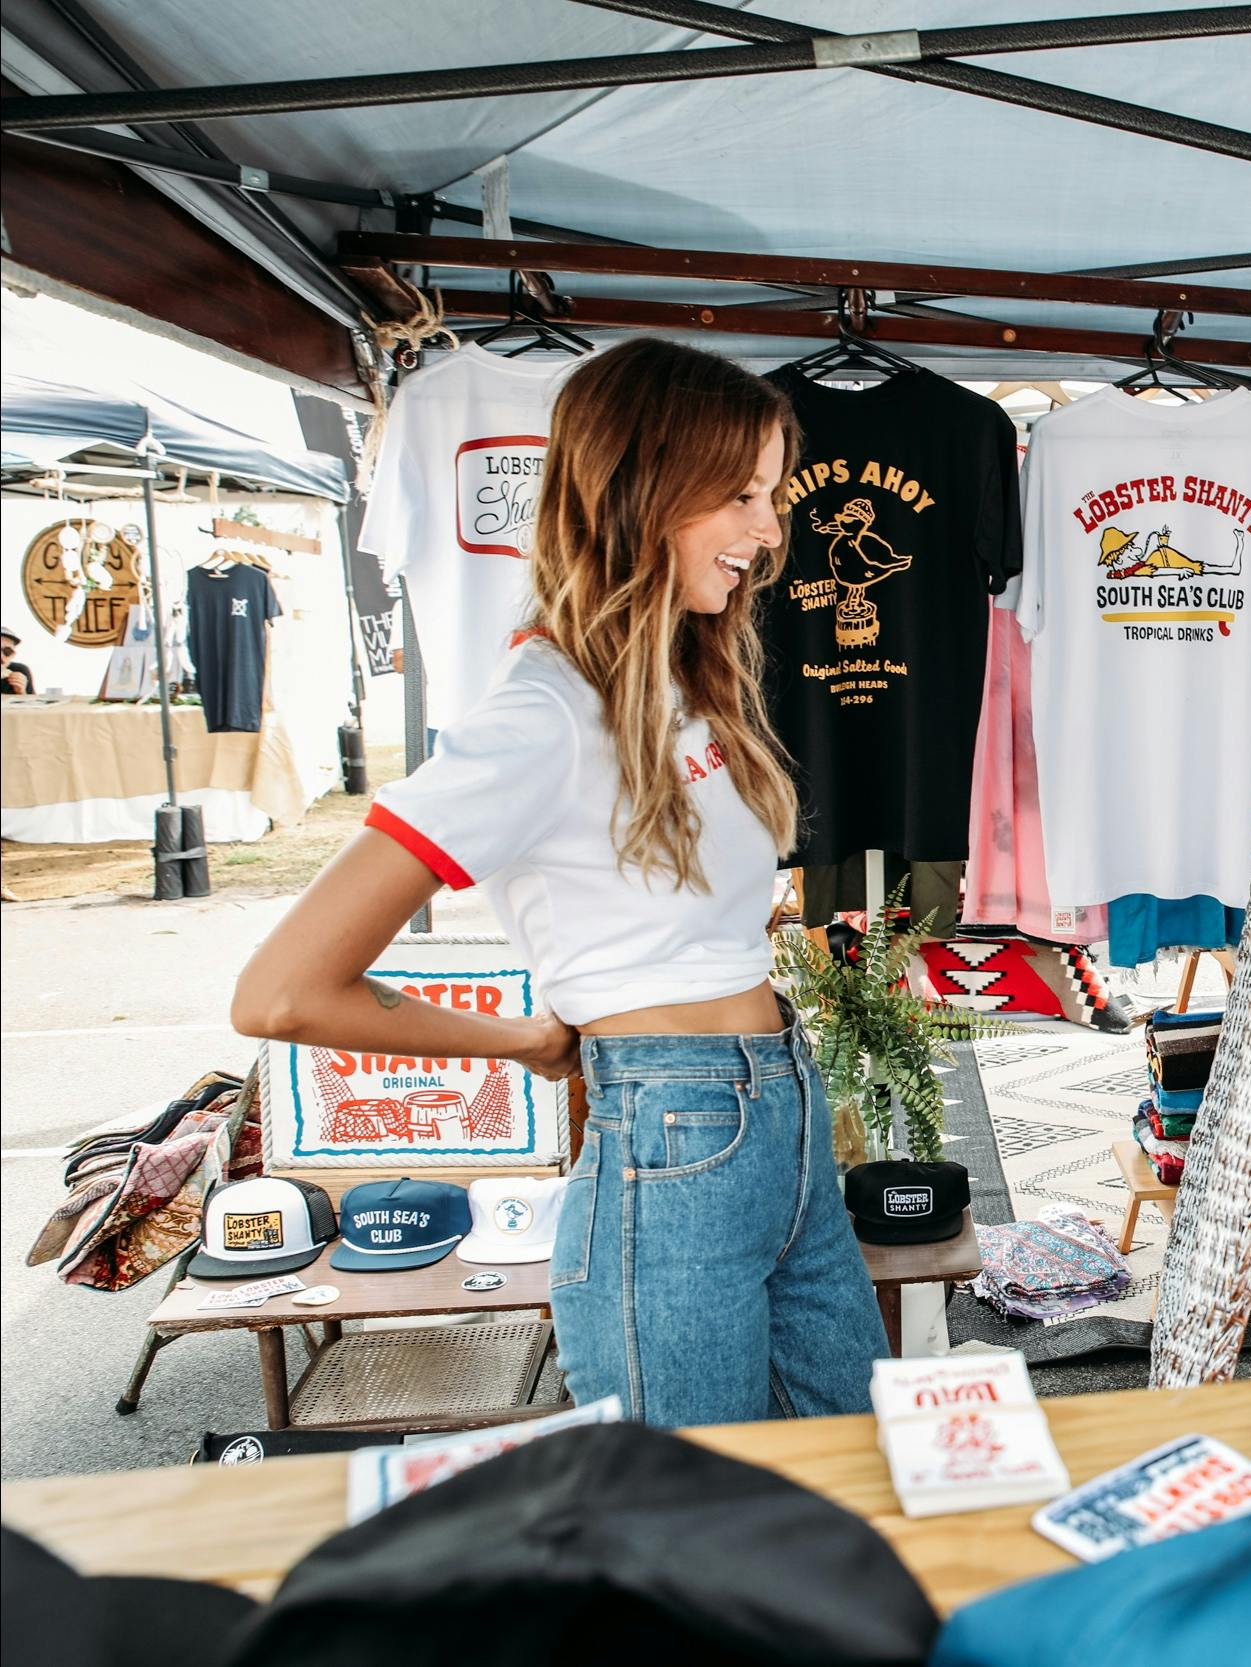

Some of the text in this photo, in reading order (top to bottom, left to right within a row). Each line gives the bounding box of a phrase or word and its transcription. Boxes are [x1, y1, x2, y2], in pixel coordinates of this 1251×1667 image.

[485, 456, 546, 476] LOBST
[777, 459, 936, 514] HIPS AHOY
[1081, 490, 1095, 503] THE
[474, 480, 538, 535] Sha
[1073, 475, 1177, 535] LOBSTER
[789, 579, 837, 600] LOBSTER
[1096, 585, 1245, 610] SOUTH SEA'S CLUB
[801, 593, 838, 612] SHANTY
[1124, 625, 1214, 642] TROPICAL DRINKS
[843, 659, 880, 673] Salted
[858, 680, 888, 689] HEADS
[383, 1076, 445, 1089] ORIGINAL
[888, 1193, 929, 1204] LOBSTER
[890, 1203, 928, 1212] SHANTY
[227, 1215, 270, 1230] LOBSTER
[353, 1209, 430, 1230] SOUTH SEA'S
[227, 1227, 263, 1241] SHANTY
[370, 1229, 402, 1244] CLUB
